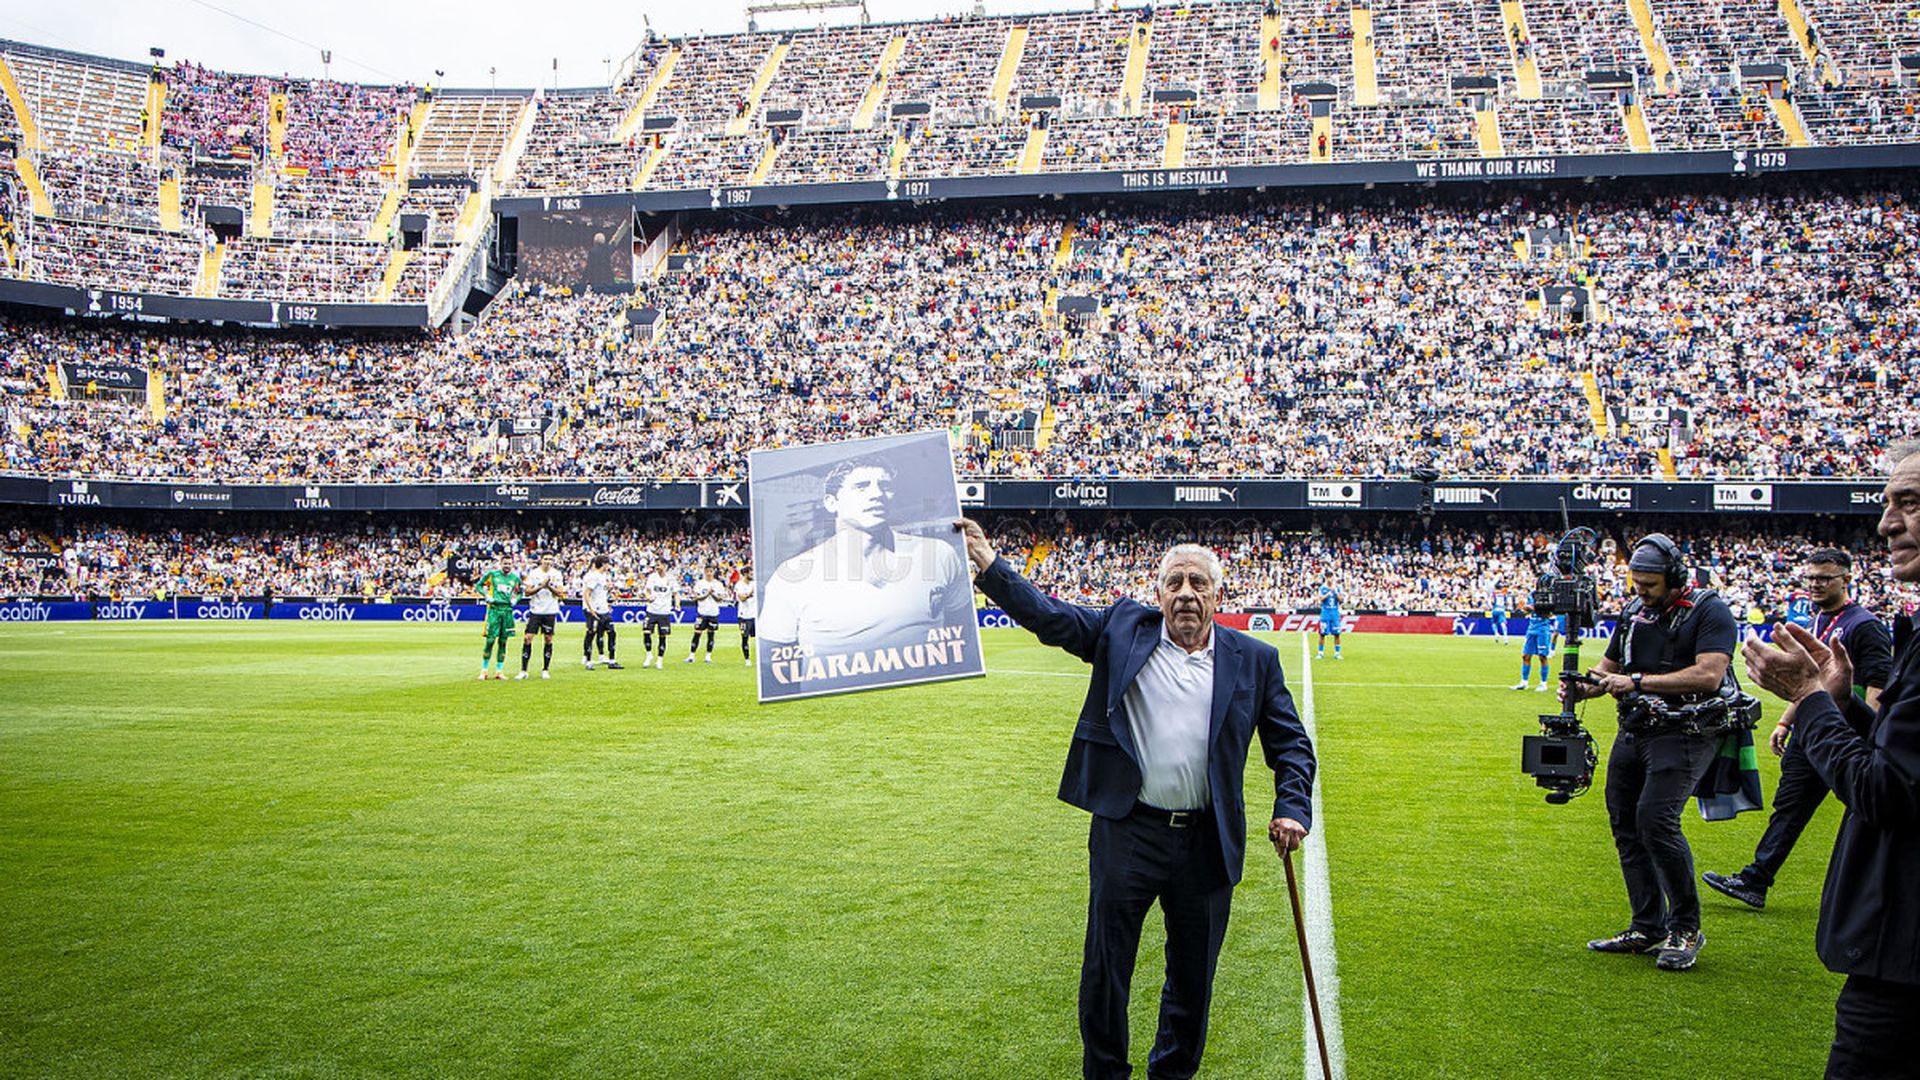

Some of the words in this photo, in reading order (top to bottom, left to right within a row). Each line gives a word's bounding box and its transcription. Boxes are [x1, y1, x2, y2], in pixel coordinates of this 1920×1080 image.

[1753, 152, 1787, 167] 1979
[1416, 162, 1437, 178] WE
[1440, 161, 1483, 177] THANK
[1486, 160, 1514, 176] OUR
[1517, 158, 1556, 175] FANS!
[1122, 173, 1150, 188] THIS
[1153, 172, 1165, 187] IS
[1169, 169, 1228, 186] MESTALLA
[726, 188, 752, 203] 1967
[904, 181, 930, 196] 1971
[111, 295, 143, 312] 1954
[287, 306, 318, 321] 1962
[1055, 483, 1107, 498] divina
[1175, 486, 1222, 501] PUMA
[1312, 487, 1330, 497] TM
[1434, 487, 1484, 503] PUMA
[1573, 484, 1632, 500] divina
[1718, 490, 1738, 500] TM
[59, 493, 101, 505] TURIA
[294, 498, 331, 509] TURIA
[0, 602, 52, 621] cabify
[198, 602, 253, 620] cabify
[299, 603, 355, 621] cabify
[402, 603, 461, 622] cabify
[1792, 601, 1809, 614] 47
[927, 625, 964, 643] ANY
[771, 639, 966, 684] CLARAMUNT
